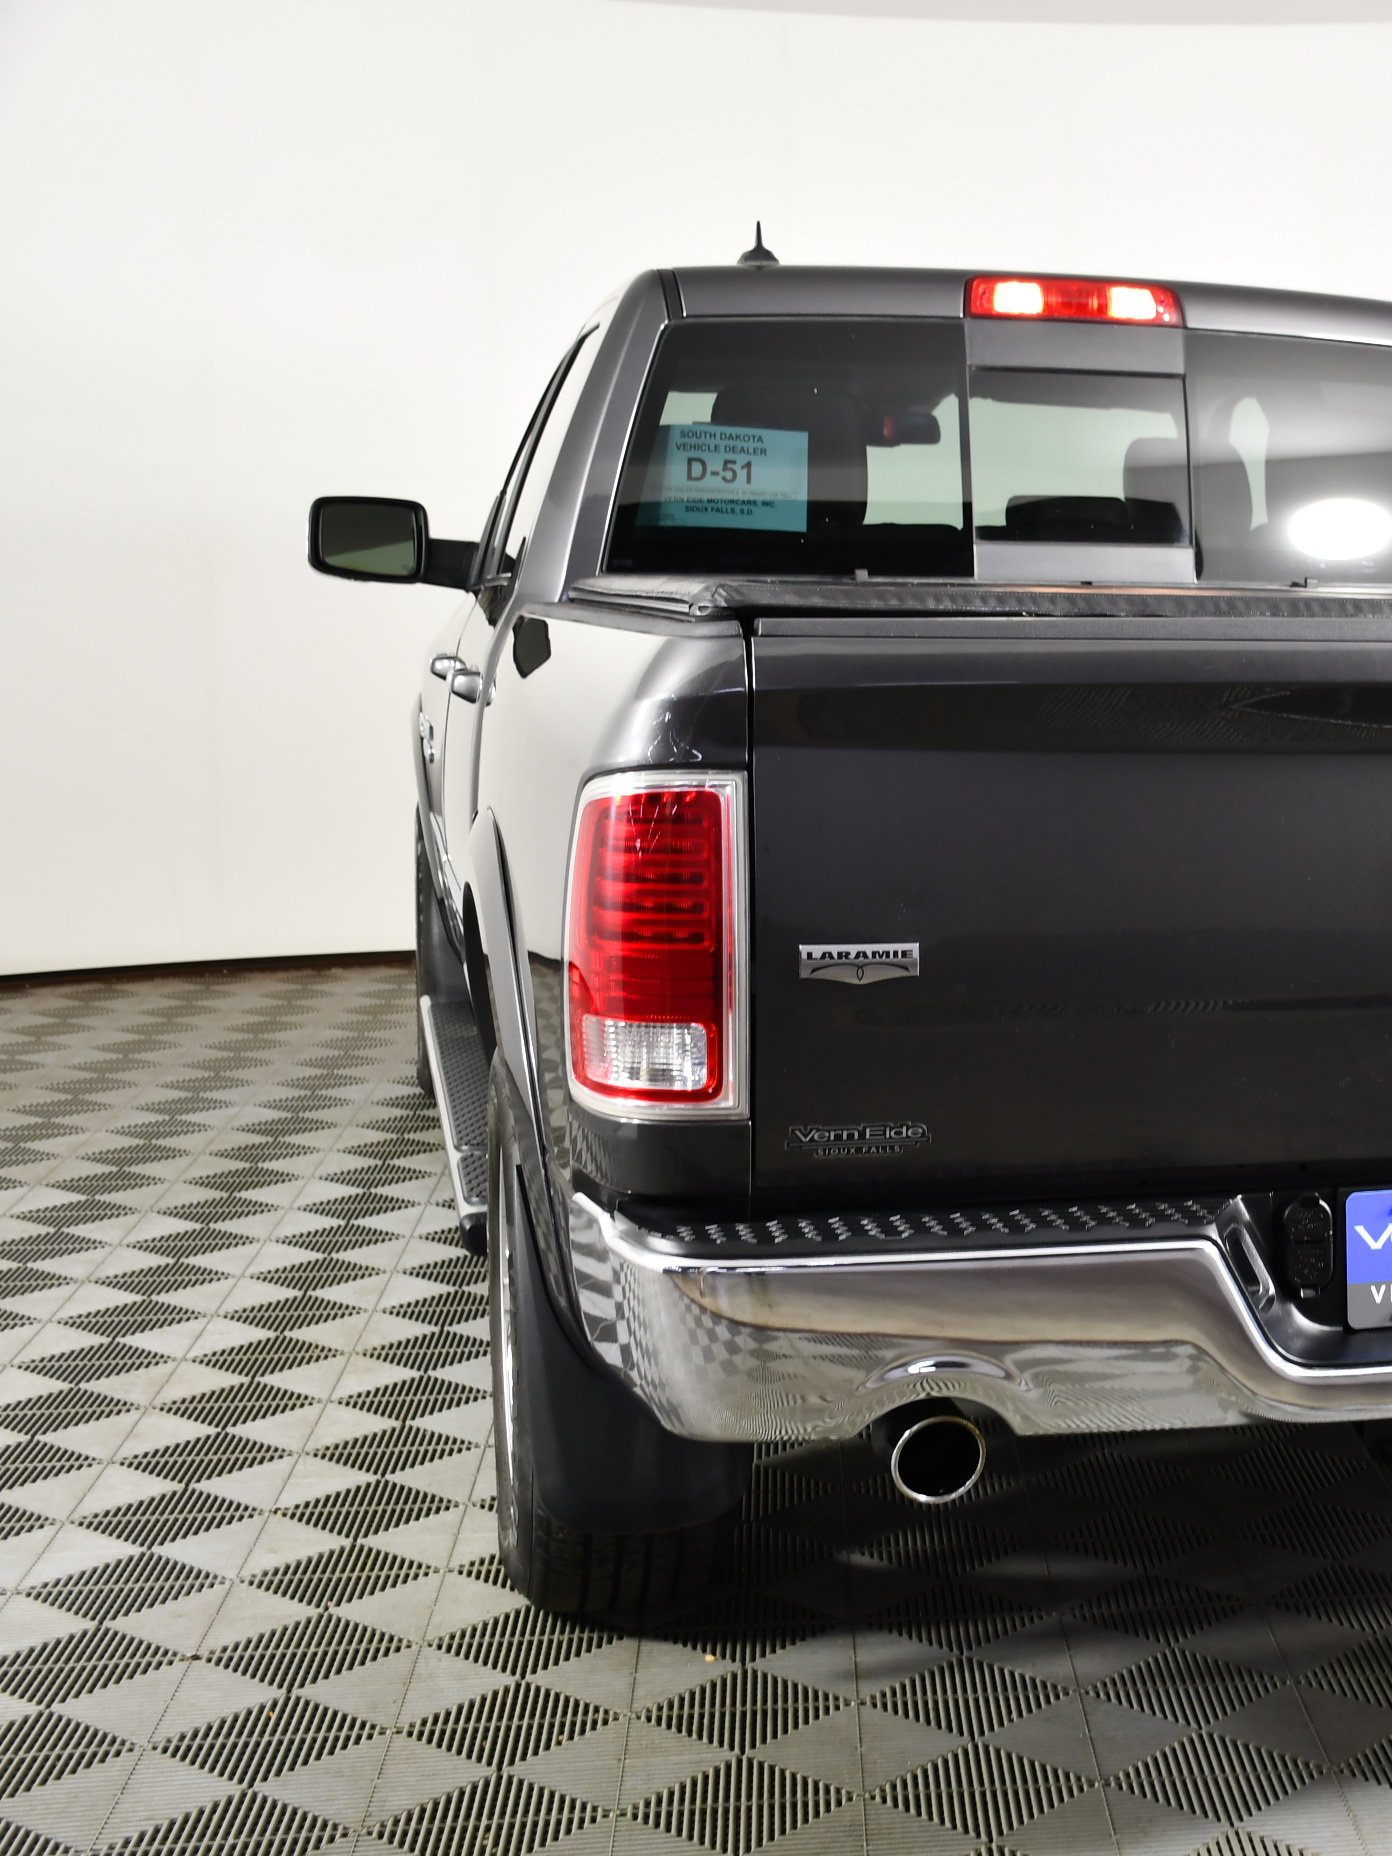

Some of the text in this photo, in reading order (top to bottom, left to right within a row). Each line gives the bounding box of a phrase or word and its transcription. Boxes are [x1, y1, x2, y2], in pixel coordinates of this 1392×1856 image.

[680, 430, 764, 444] SOUTH DAKOTA
[675, 442, 767, 456] VEHICLE DEALER
[686, 457, 753, 485] D-51
[685, 505, 709, 513] SIOUX
[806, 949, 914, 961] LARAMIE
[794, 1124, 924, 1143] Vern Eide
[817, 1144, 901, 1156] SIOUX FALLS
